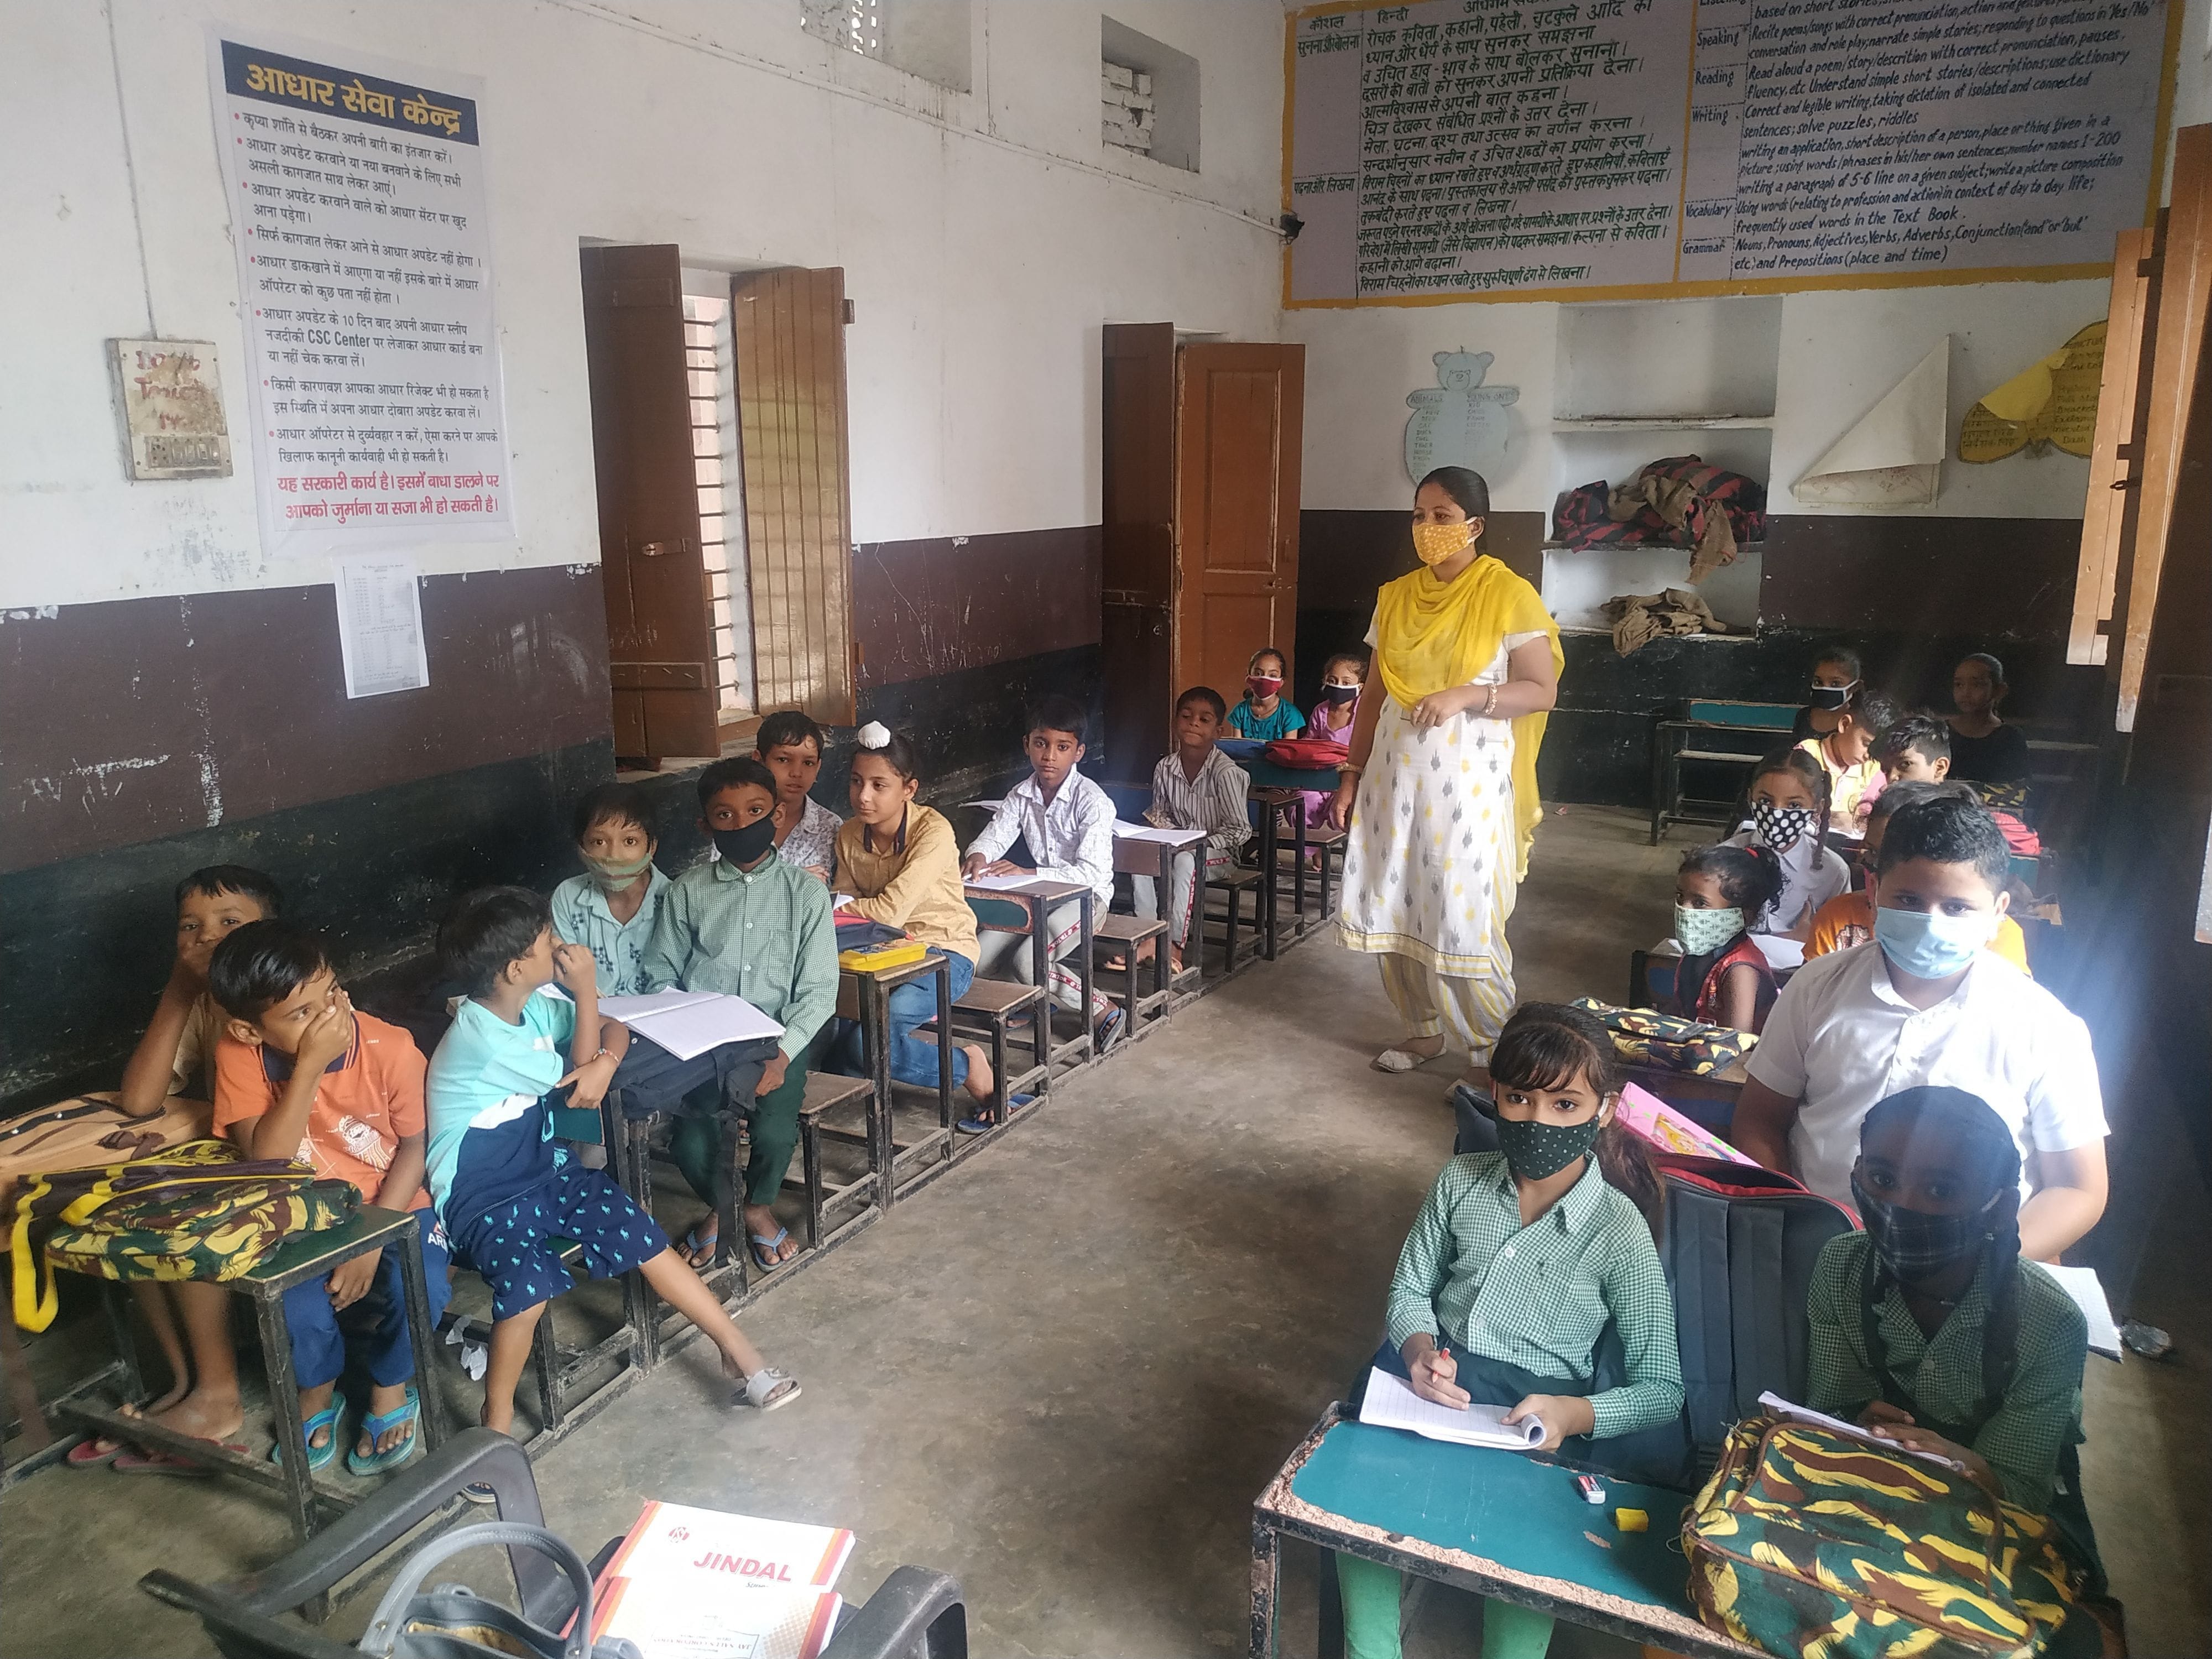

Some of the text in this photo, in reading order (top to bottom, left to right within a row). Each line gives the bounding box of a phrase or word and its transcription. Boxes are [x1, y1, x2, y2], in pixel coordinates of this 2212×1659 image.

[1378, 8, 1409, 24] हिन्दी
[1455, 39, 1481, 54] साथ
[1697, 31, 1739, 49] Speaking
[1695, 70, 1734, 87] Reading
[1749, 62, 1775, 80] Read
[1775, 60, 1803, 78] aloud
[246, 63, 462, 136] आधार सेवा केन्द्र
[1797, 119, 1825, 134] solve
[1879, 110, 1918, 128] riddles
[271, 117, 295, 134] शांति
[298, 120, 307, 136] से
[310, 122, 338, 142] बैठकर
[342, 132, 366, 147] अपनी
[369, 137, 387, 152] बारी
[389, 143, 403, 154] का
[405, 143, 431, 160] इंतजार
[247, 138, 461, 187] आधार अपडेट करवाने या नया बनवाने के लिए सभी
[1786, 175, 1835, 194] paragraph
[1686, 203, 1733, 219] Vocabulary
[1788, 215, 1817, 231] used
[1819, 213, 1851, 228] words
[1854, 212, 1865, 226] in
[1867, 211, 1887, 225] the
[1892, 207, 1921, 224] Text
[1928, 205, 1959, 221] Book
[1884, 248, 1907, 263] and
[263, 308, 467, 335] आधार अपडेट के 10 दिन बाद अपनी आधार स्लीप
[264, 327, 483, 355] नजदीकी CSC Center पर लेजाकर आधार कार्ड बना
[270, 375, 489, 400] किसी कारणवश आपका आधार रिजेक्ट भी हो सकता है
[277, 429, 306, 440] आधार
[309, 425, 345, 440] ऑपरेटर
[346, 426, 355, 441] से
[395, 431, 403, 441] न
[424, 427, 440, 444] ऐसा
[442, 428, 461, 442] करने
[463, 432, 473, 441] पर
[476, 429, 498, 442] आपके
[277, 478, 298, 492] यह
[301, 471, 347, 491] सरकारी
[350, 471, 376, 489] कार्य
[397, 471, 426, 491] इसमें
[427, 476, 451, 488] बाधा
[453, 471, 483, 489] डालने
[486, 476, 499, 487] पर
[286, 499, 328, 519] आपको
[331, 498, 372, 524] जुर्माना
[374, 503, 388, 515] या
[391, 502, 417, 515] सजा
[420, 495, 433, 513] भी
[435, 496, 447, 514] हो
[450, 495, 482, 513] सकती
[693, 1552, 792, 1582] JINDAL
